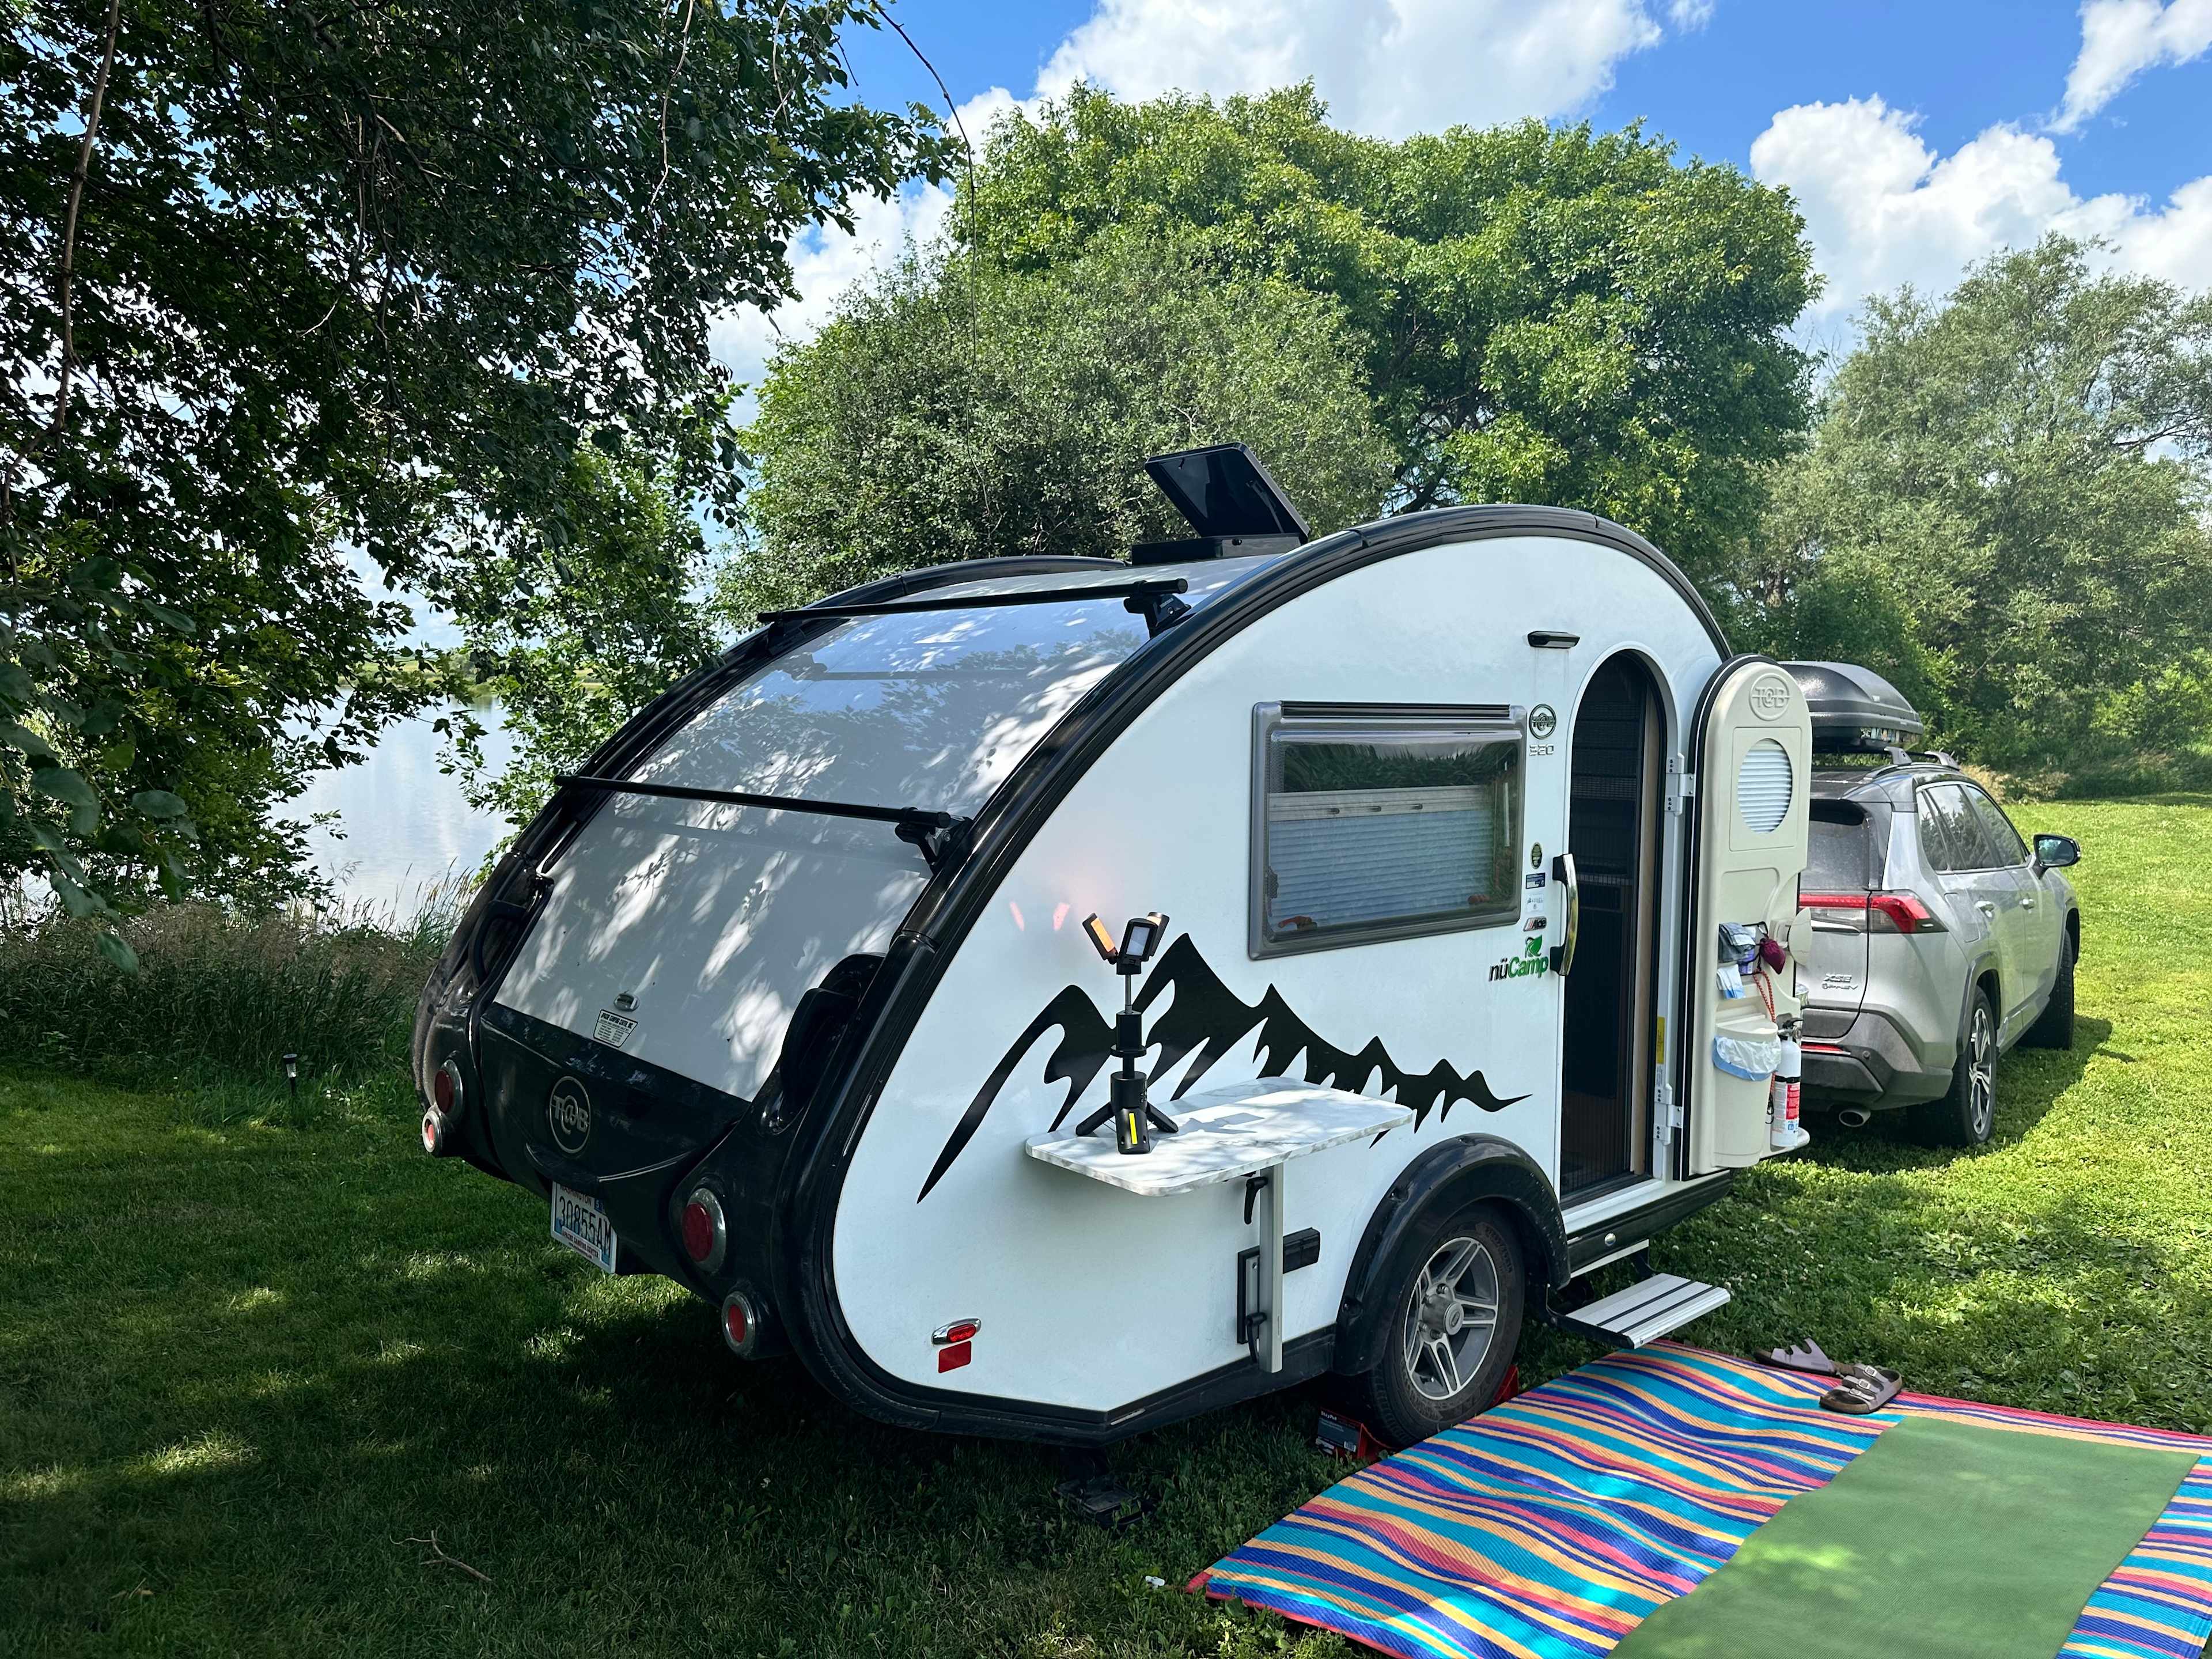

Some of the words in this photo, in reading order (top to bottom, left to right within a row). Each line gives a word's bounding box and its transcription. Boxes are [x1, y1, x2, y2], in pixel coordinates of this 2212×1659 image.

[1529, 744, 1554, 756] 320
[1488, 956, 1549, 982] nüCamp
[1824, 973, 1852, 983] XSE
[559, 1196, 612, 1257] 30855AM
